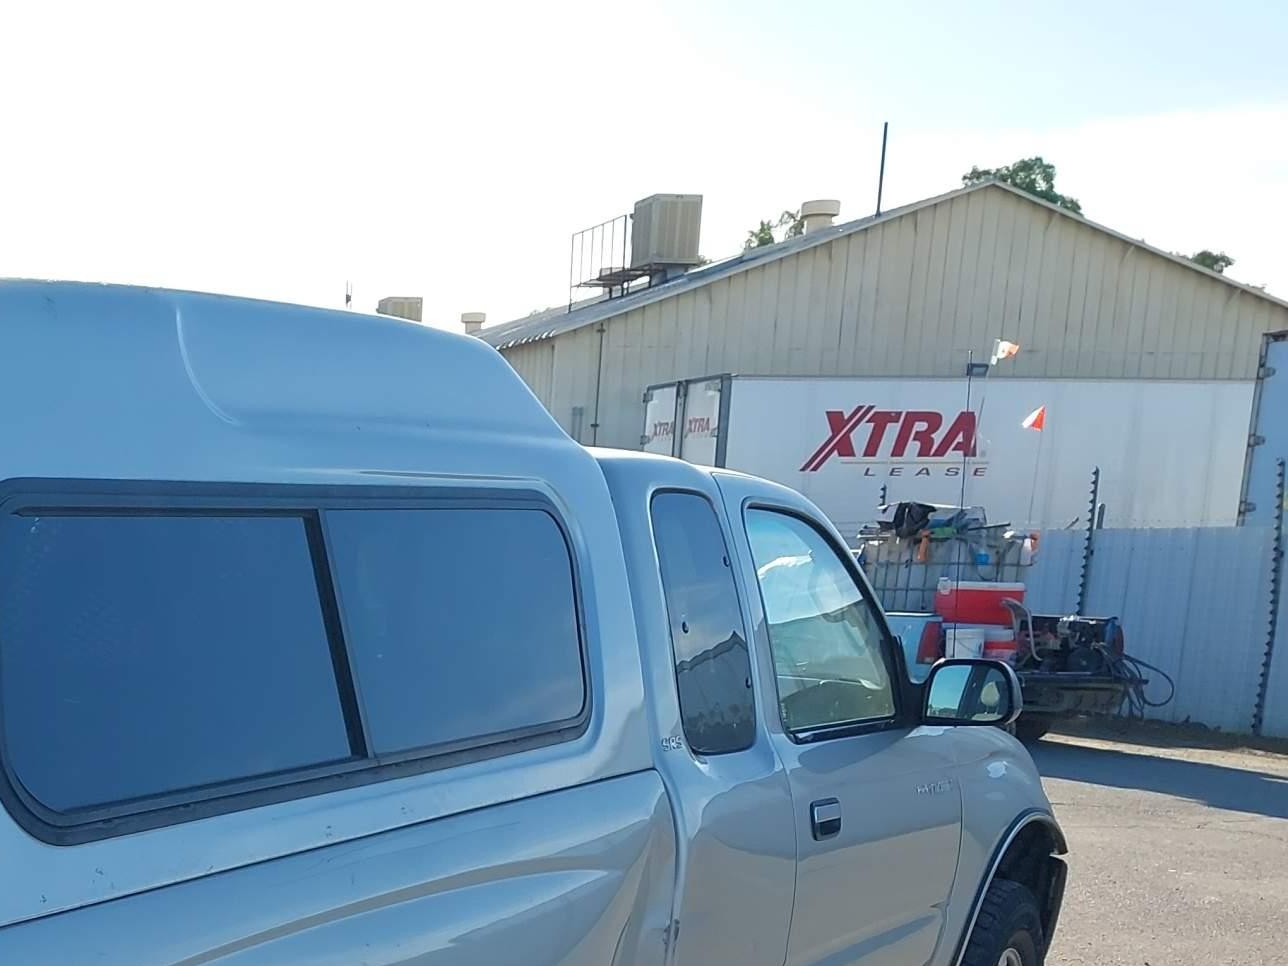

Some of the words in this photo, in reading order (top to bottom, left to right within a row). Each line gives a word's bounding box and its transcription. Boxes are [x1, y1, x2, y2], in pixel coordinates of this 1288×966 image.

[684, 416, 711, 439] XTRA
[800, 405, 978, 472] XTRA
[864, 467, 988, 477] LEASE
